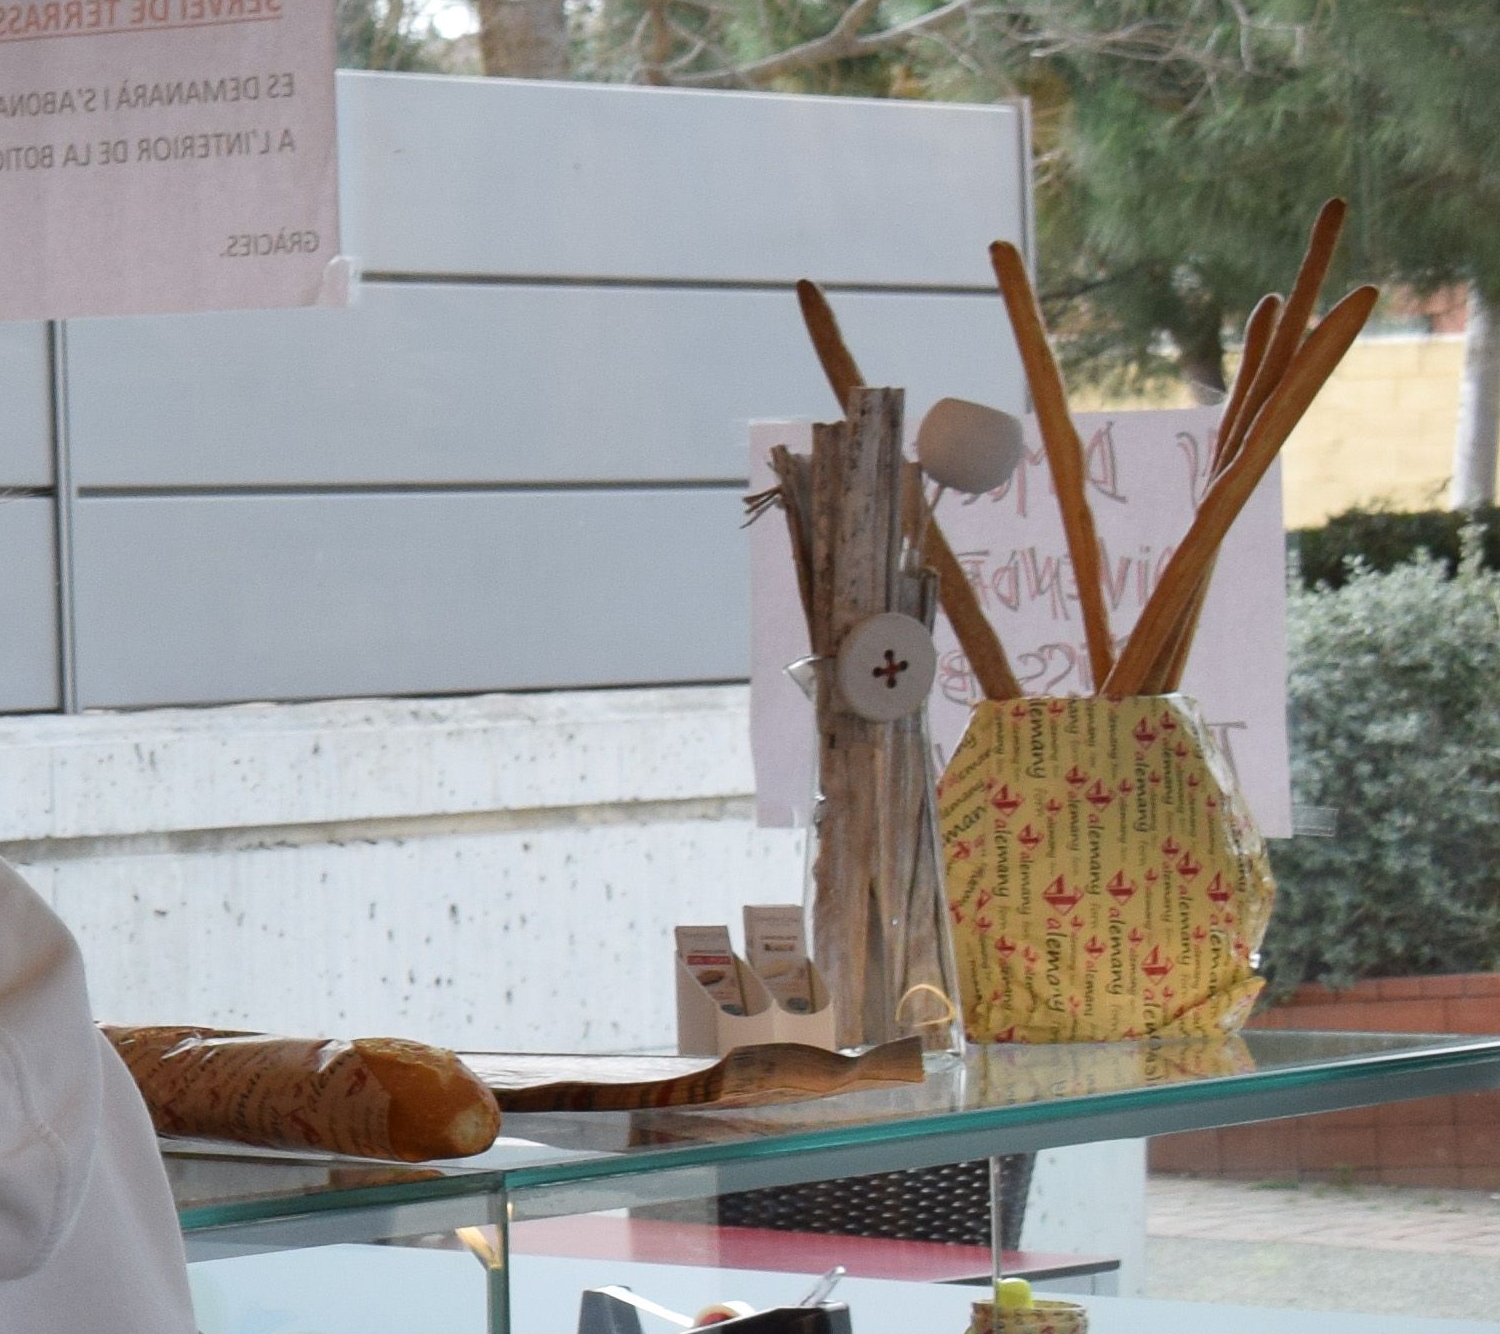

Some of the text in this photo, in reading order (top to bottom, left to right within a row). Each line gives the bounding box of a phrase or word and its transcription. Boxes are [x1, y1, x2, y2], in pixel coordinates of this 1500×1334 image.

[1024, 699, 1047, 779] lemany
[1132, 751, 1150, 833] alemany
[1084, 813, 1104, 896] alemany
[1103, 907, 1126, 996] alemany
